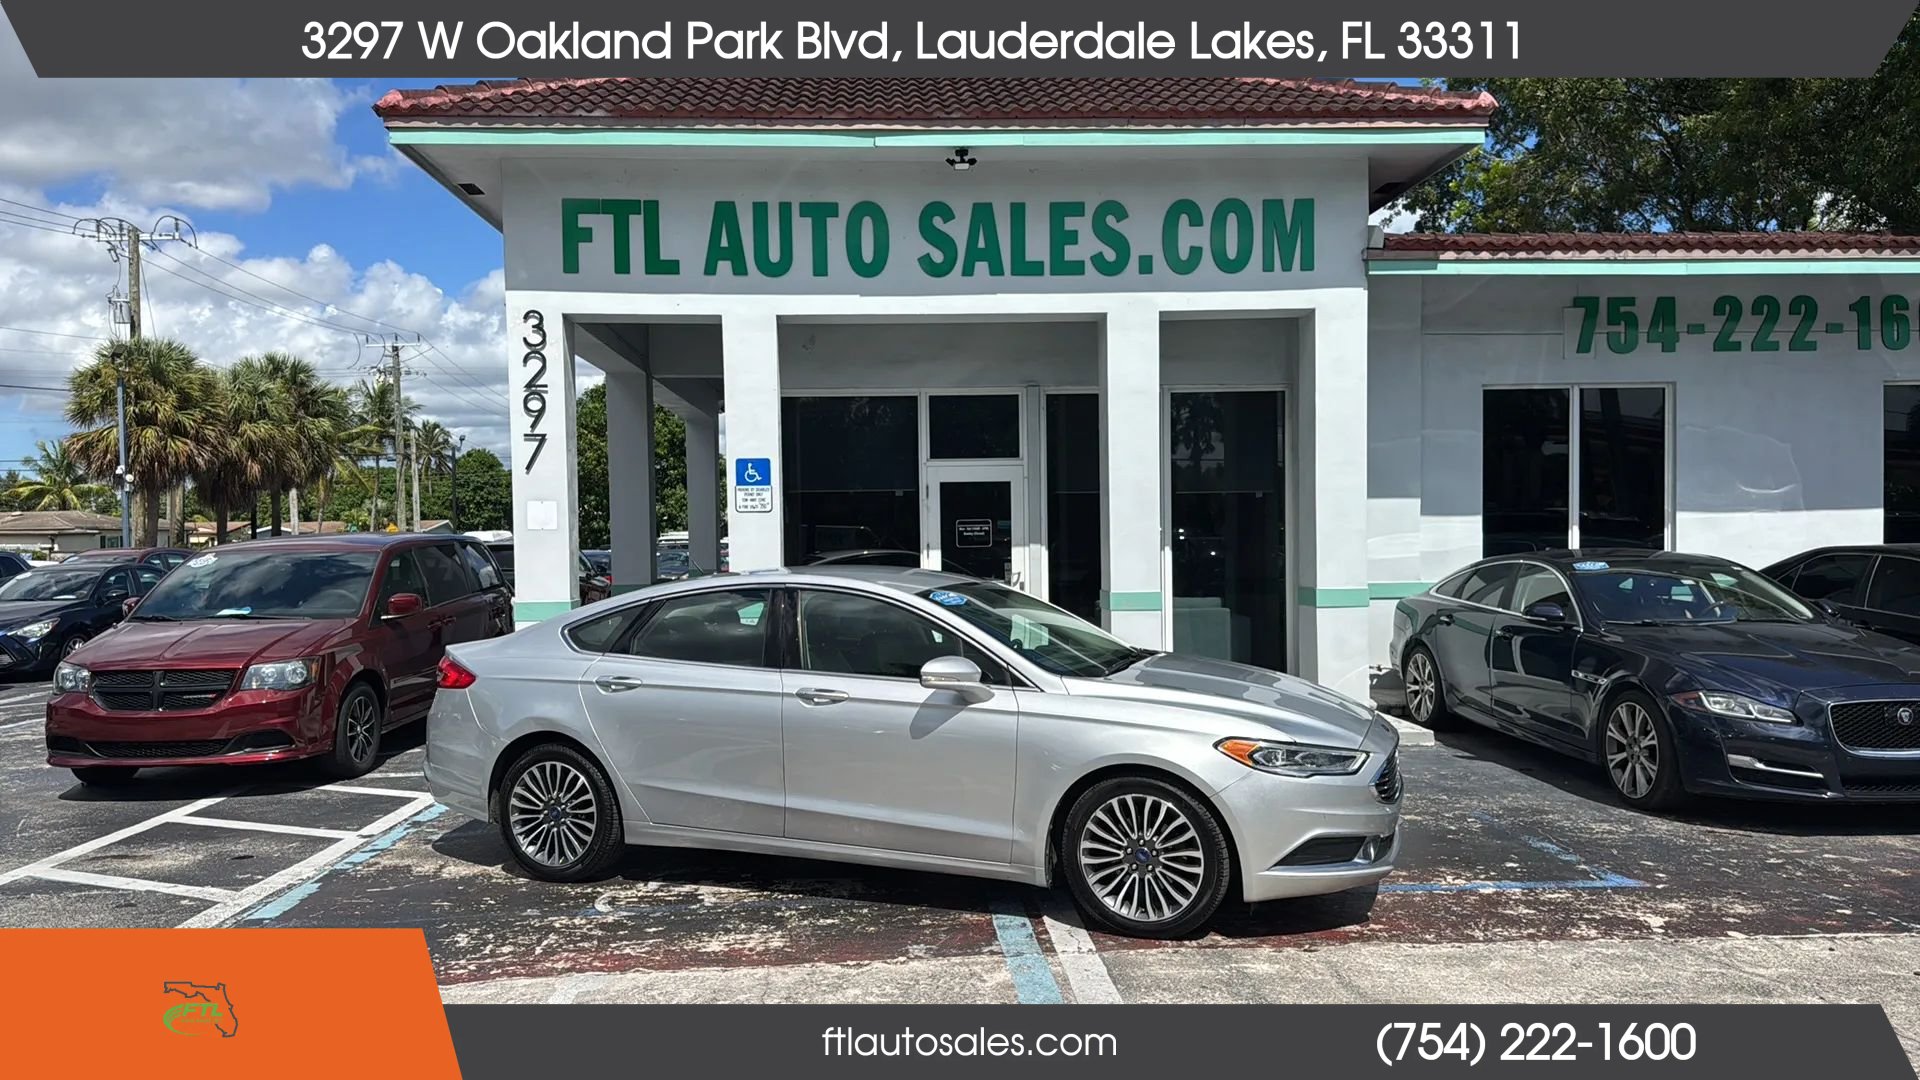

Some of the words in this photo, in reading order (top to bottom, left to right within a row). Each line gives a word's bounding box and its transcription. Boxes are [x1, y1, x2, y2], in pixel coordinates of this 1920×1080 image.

[561, 198, 680, 276] FTL
[703, 200, 891, 279] AUTO
[916, 197, 1317, 278] SALES.COM
[1573, 294, 1920, 354] 754-222-16
[522, 309, 549, 474] 3297
